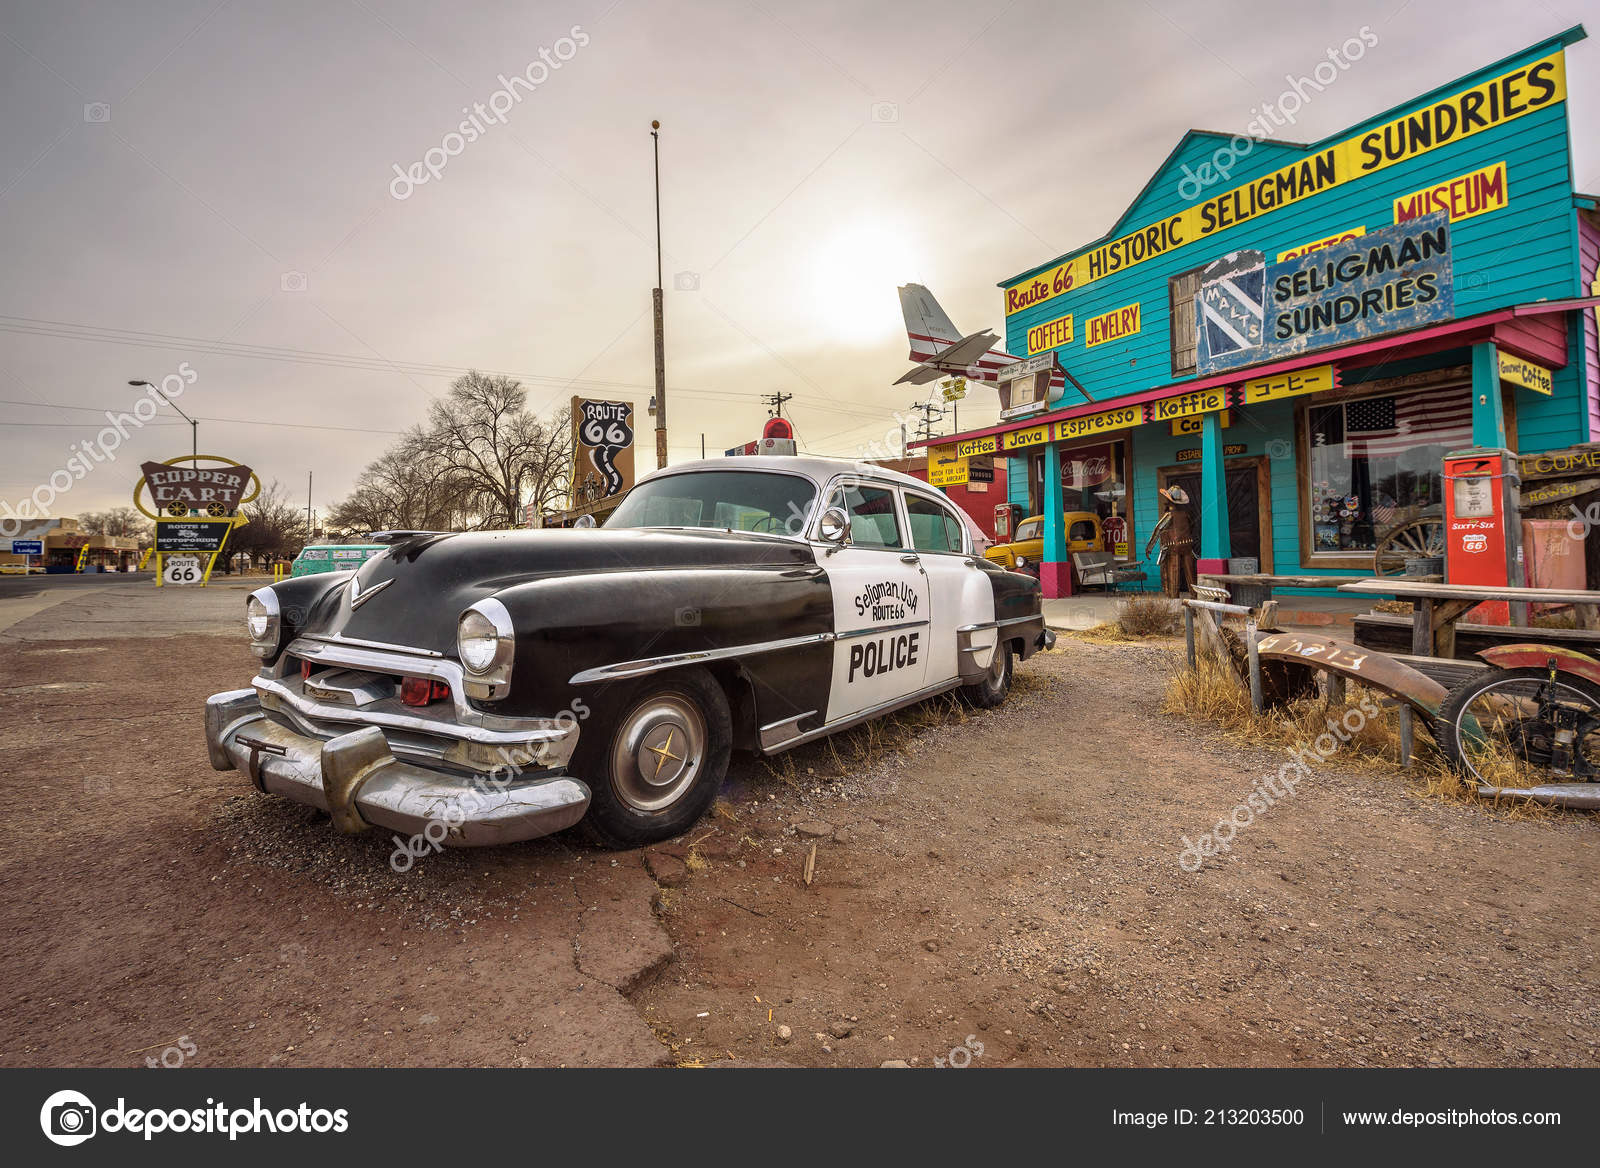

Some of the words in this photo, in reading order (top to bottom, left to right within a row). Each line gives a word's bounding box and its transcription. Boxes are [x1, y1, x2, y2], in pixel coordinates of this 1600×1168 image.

[1008, 278, 1049, 313] Route
[1053, 263, 1074, 294] 66
[1089, 217, 1183, 279] HISTORIC
[1201, 150, 1335, 233] SELIGMAN
[1361, 62, 1555, 170] SUNDRIES
[1397, 166, 1503, 223] MUSEUM
[1274, 226, 1447, 301] SELIGMAN
[1206, 287, 1259, 338] MALTS
[1275, 273, 1438, 339] SUNDRIES
[1028, 317, 1071, 352] COFFEE
[1088, 305, 1138, 345] JEWELRY
[1255, 376, 1320, 397] コーヒー
[1522, 365, 1550, 391] Coffee
[587, 405, 625, 421] ROUTE
[1159, 393, 1219, 418] Koffie
[584, 419, 626, 444] 66
[1060, 410, 1135, 438] Espresso
[1181, 419, 1203, 432] Ca
[959, 440, 994, 456] Kaffee
[1010, 431, 1042, 446] Java
[149, 470, 241, 488] COPPER
[156, 486, 238, 502] CART
[1529, 484, 1577, 503] Howdy
[1452, 521, 1495, 530] SIXTY-SIX
[1466, 542, 1483, 550] 66
[171, 568, 194, 581] 66
[901, 581, 918, 615] USA
[873, 605, 894, 621] ROUTE
[895, 604, 905, 620] 66
[848, 632, 919, 683] POLICE
